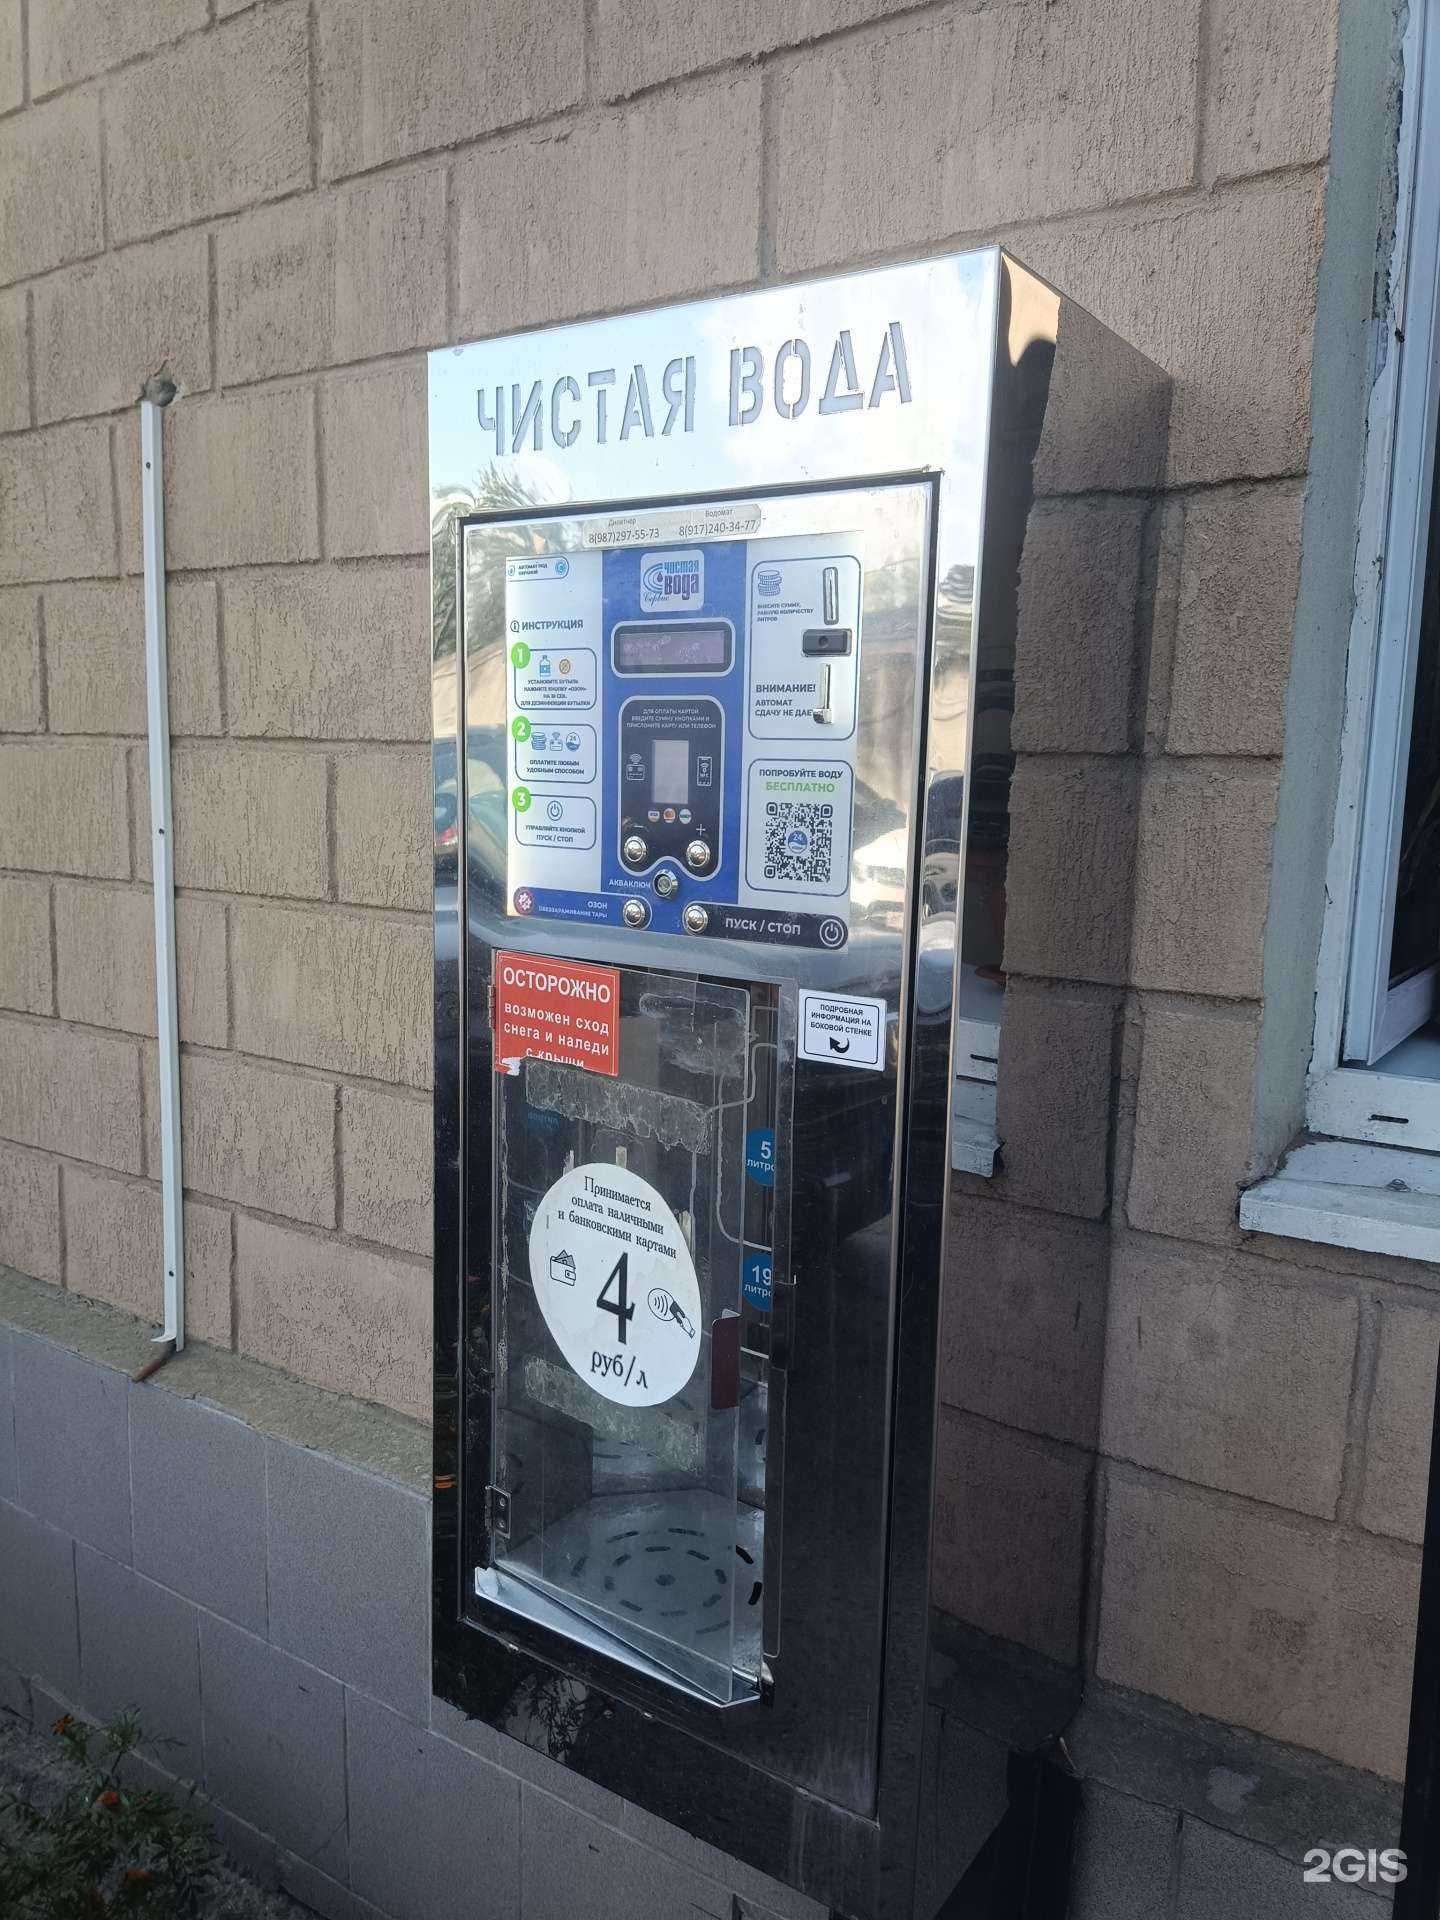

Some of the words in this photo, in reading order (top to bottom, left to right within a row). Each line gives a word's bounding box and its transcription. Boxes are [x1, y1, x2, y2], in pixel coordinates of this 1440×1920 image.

[477, 356, 696, 456] ЧИСТАЯ
[728, 321, 913, 427] ВОДА
[705, 509, 733, 518] Водомат
[678, 519, 757, 537] 8(917)240-34-77
[588, 528, 660, 545] 8(987)297-55-73
[522, 619, 584, 631] ИНСТРУКЦИЯ
[517, 648, 523, 663] 1
[755, 683, 816, 693] ВНИМАНИЕ!
[755, 699, 792, 707] АВТОМАТ
[755, 709, 781, 717] СДАЧУ
[783, 709, 793, 717] НЕ
[795, 709, 813, 718] ДАЕ
[517, 722, 526, 736] 2
[760, 769, 817, 778] ПОПРОБУЙТЕ
[818, 770, 843, 779] ВОДУ
[766, 781, 835, 792] БЕСПЛАТНО
[518, 792, 526, 806] 3
[609, 879, 650, 889] АКВАКЛЮЧ
[587, 900, 608, 910] ОЗОН
[725, 917, 757, 930] ПУСК
[767, 921, 801, 935] СТОП
[503, 966, 611, 1003] ОСТОРОЖНО
[820, 1004, 864, 1016] ПОДРОБНАЯ
[504, 1002, 571, 1026] возможен
[576, 1017, 609, 1037] сход
[811, 1011, 860, 1025] ИНФОРМАЦИЯ
[861, 1019, 872, 1027] НА
[810, 1021, 843, 1033] БОКОВОЙ
[845, 1026, 873, 1037] СТЕНКЕ
[504, 1022, 540, 1040] снега
[545, 1031, 553, 1042] и
[558, 1034, 609, 1056] наледи
[760, 1140, 772, 1160] 5
[584, 1175, 651, 1212] Принимается
[571, 1196, 604, 1214] оплата
[607, 1206, 664, 1236] наличными
[558, 1209, 565, 1220] и
[568, 1210, 632, 1243] банковскими
[635, 1235, 677, 1259] картами
[752, 1264, 772, 1286] 19
[596, 1252, 636, 1345] 4
[590, 1351, 649, 1389] руб/л
